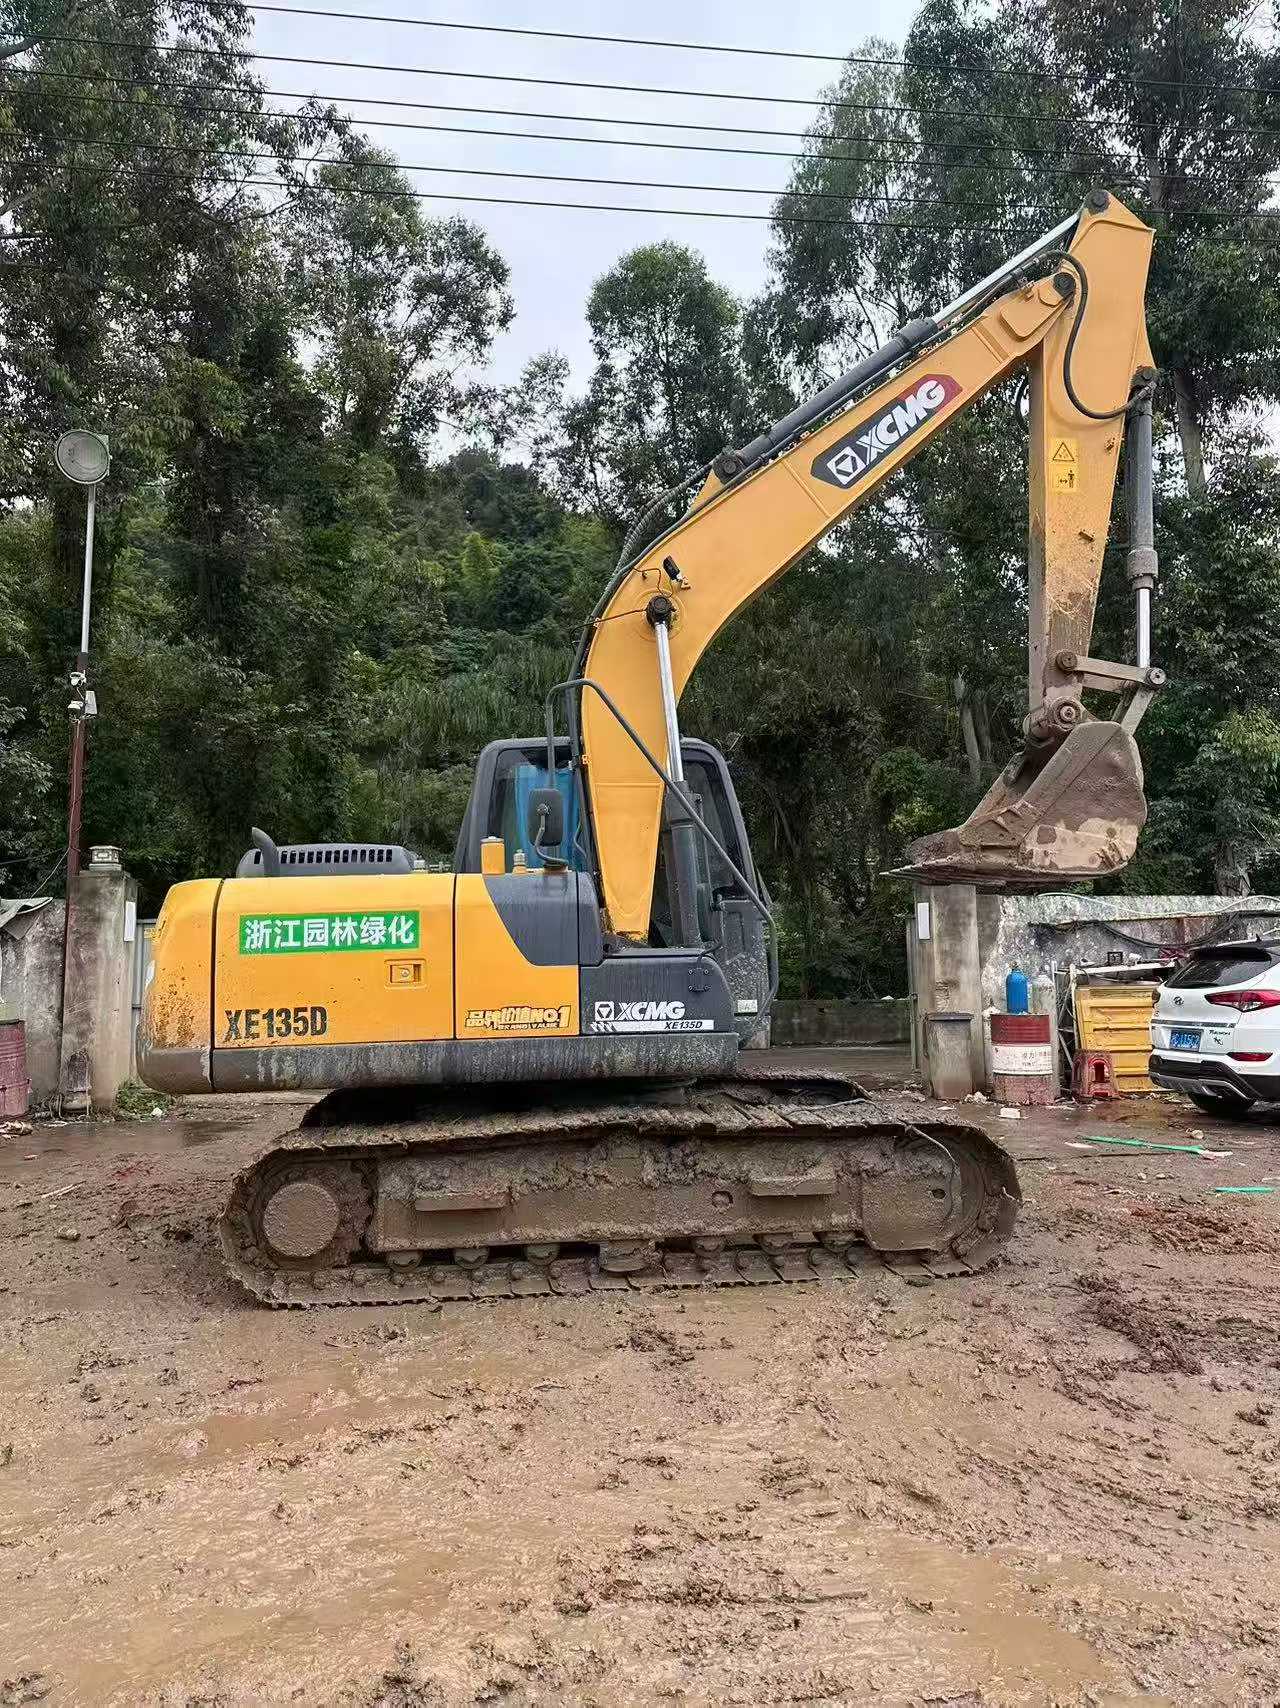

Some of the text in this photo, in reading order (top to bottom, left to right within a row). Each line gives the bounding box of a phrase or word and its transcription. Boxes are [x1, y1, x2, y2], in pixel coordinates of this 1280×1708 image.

[856, 379, 946, 466] XCMG
[244, 914, 416, 950] 浙江园林绿化
[222, 1005, 328, 1042] XE135D
[616, 1001, 686, 1021] XCMG
[663, 1020, 704, 1030] XE135D
